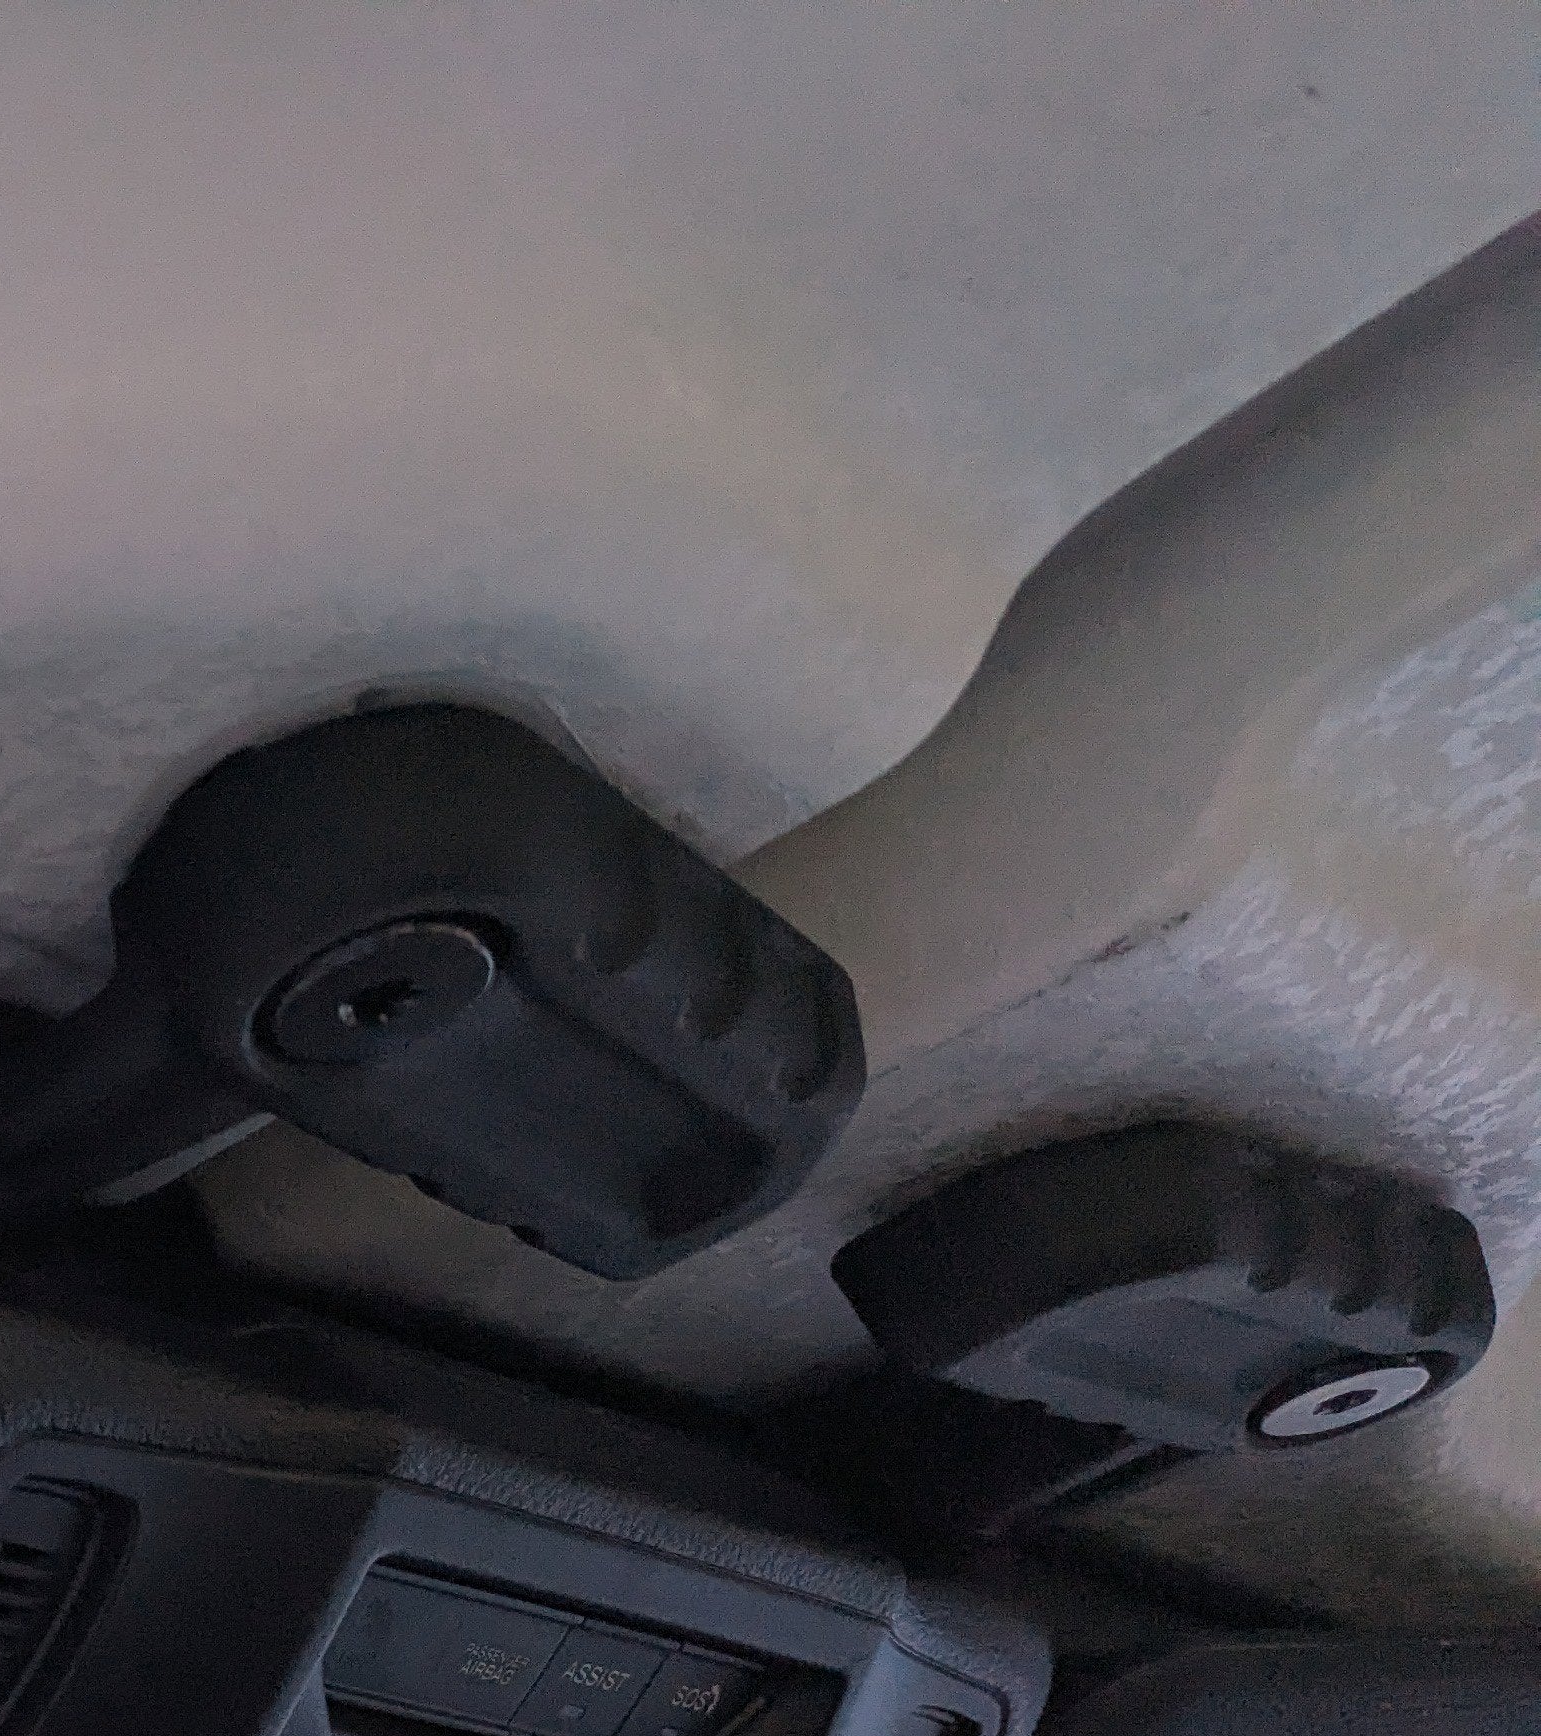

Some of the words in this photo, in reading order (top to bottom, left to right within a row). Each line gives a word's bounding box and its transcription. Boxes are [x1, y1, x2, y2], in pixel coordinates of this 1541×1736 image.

[459, 1658, 515, 1686] AIRBAG
[561, 1660, 631, 1692] ASSIST
[671, 1685, 707, 1713] SOS
